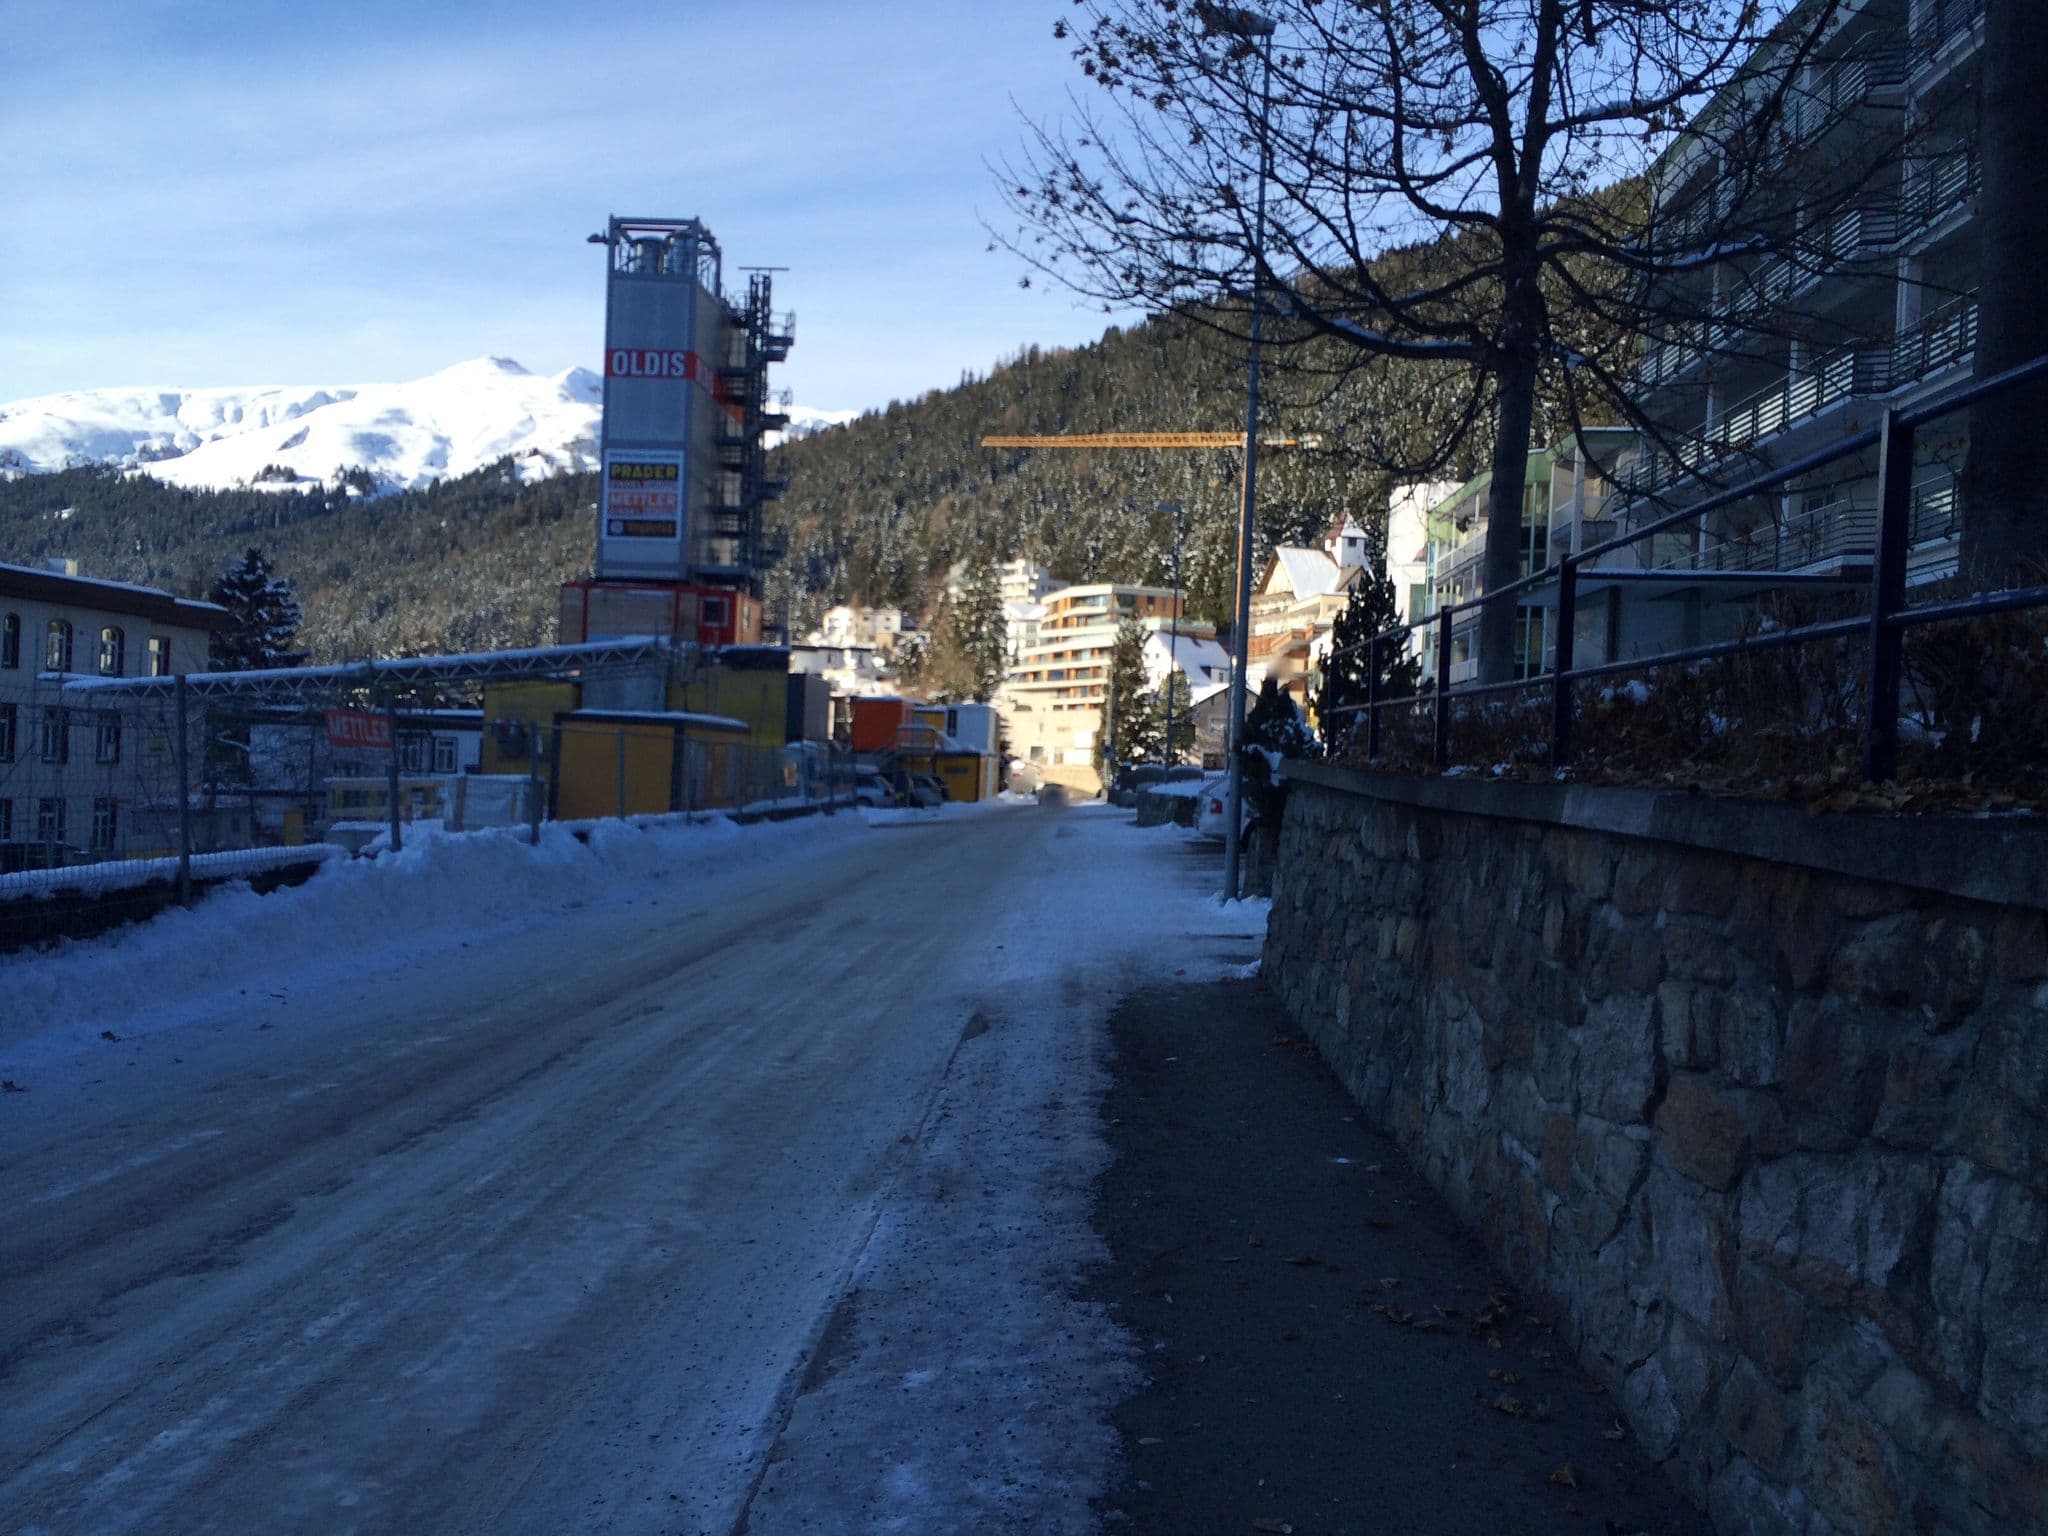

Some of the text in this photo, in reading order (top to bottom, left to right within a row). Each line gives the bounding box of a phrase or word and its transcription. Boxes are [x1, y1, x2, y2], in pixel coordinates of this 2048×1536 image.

[611, 350, 685, 376] OLDIS
[611, 464, 676, 479] PRADER
[328, 715, 390, 742] METTLER
